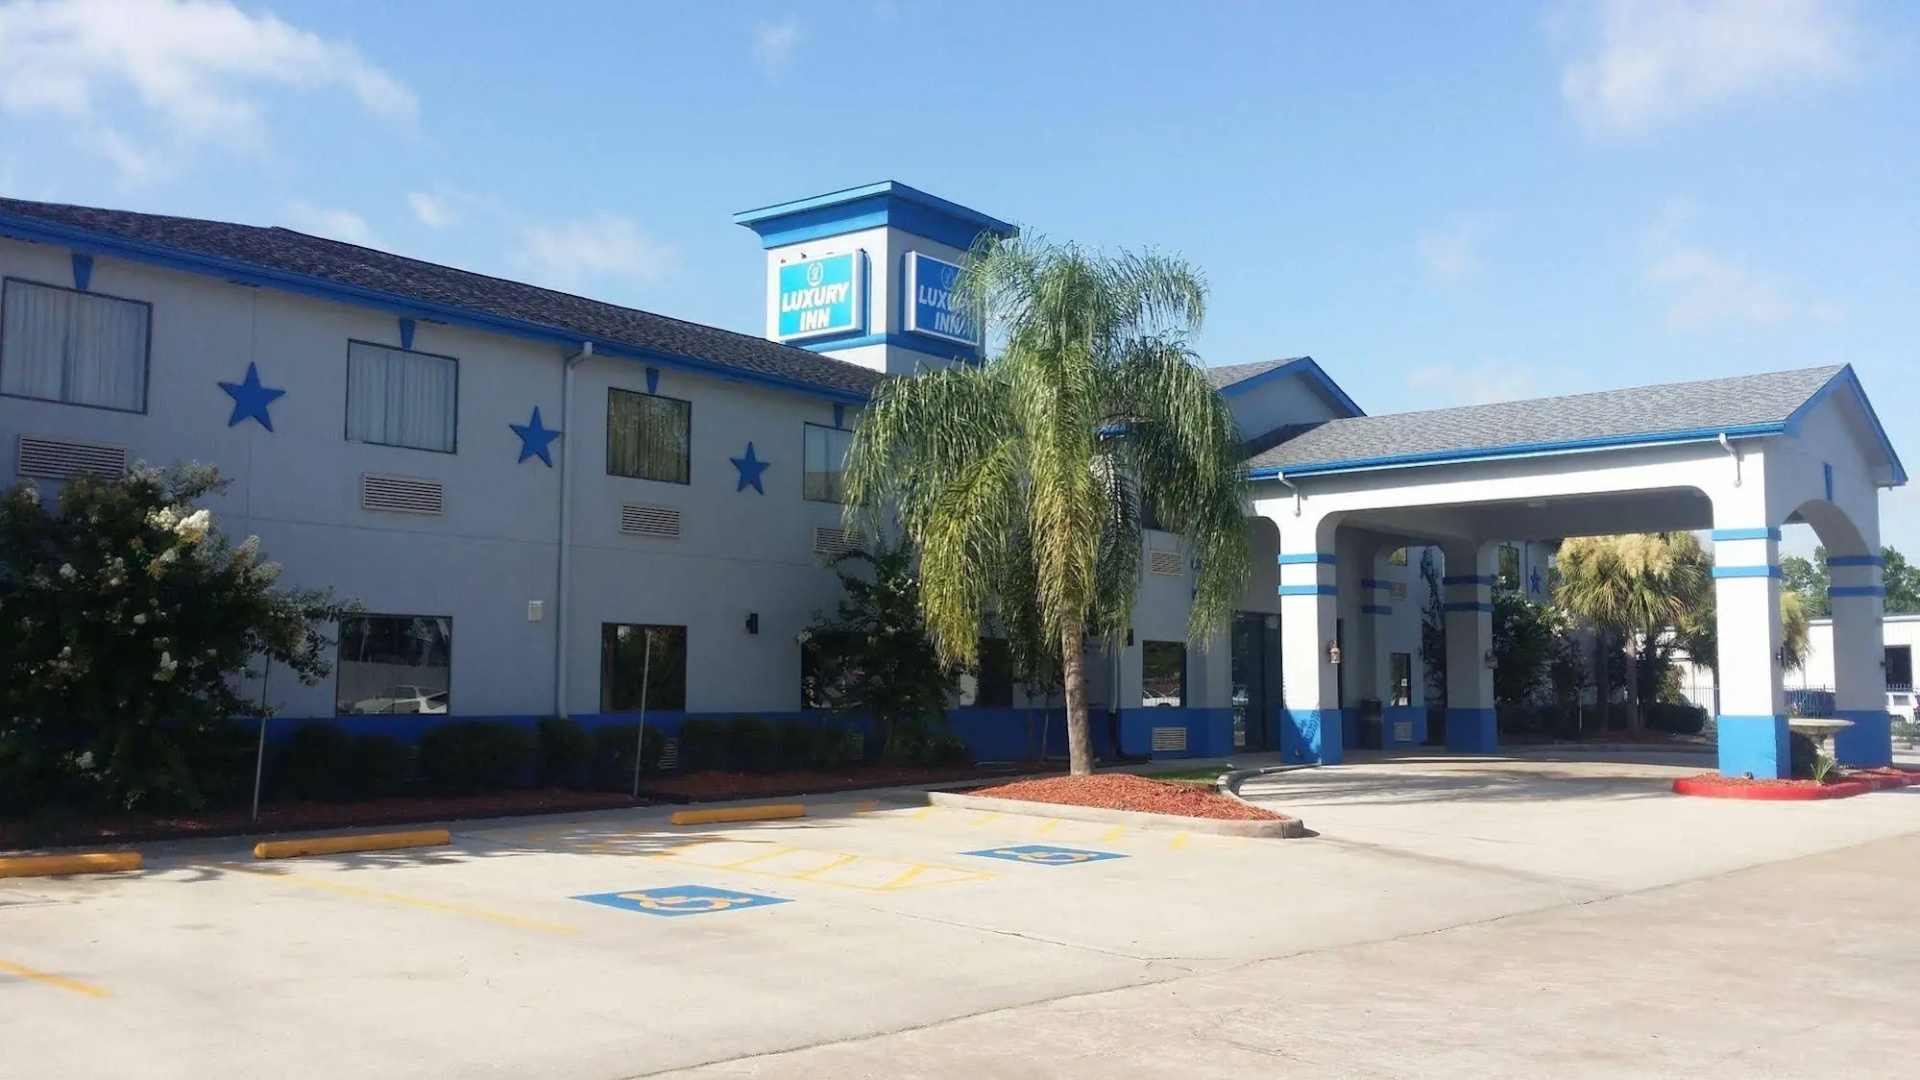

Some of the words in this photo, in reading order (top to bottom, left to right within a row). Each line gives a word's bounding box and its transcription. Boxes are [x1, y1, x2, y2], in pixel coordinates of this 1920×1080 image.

[781, 281, 850, 312] LUXURY
[919, 285, 964, 316] LUX
[800, 306, 830, 333] INN
[934, 311, 963, 335] INN
